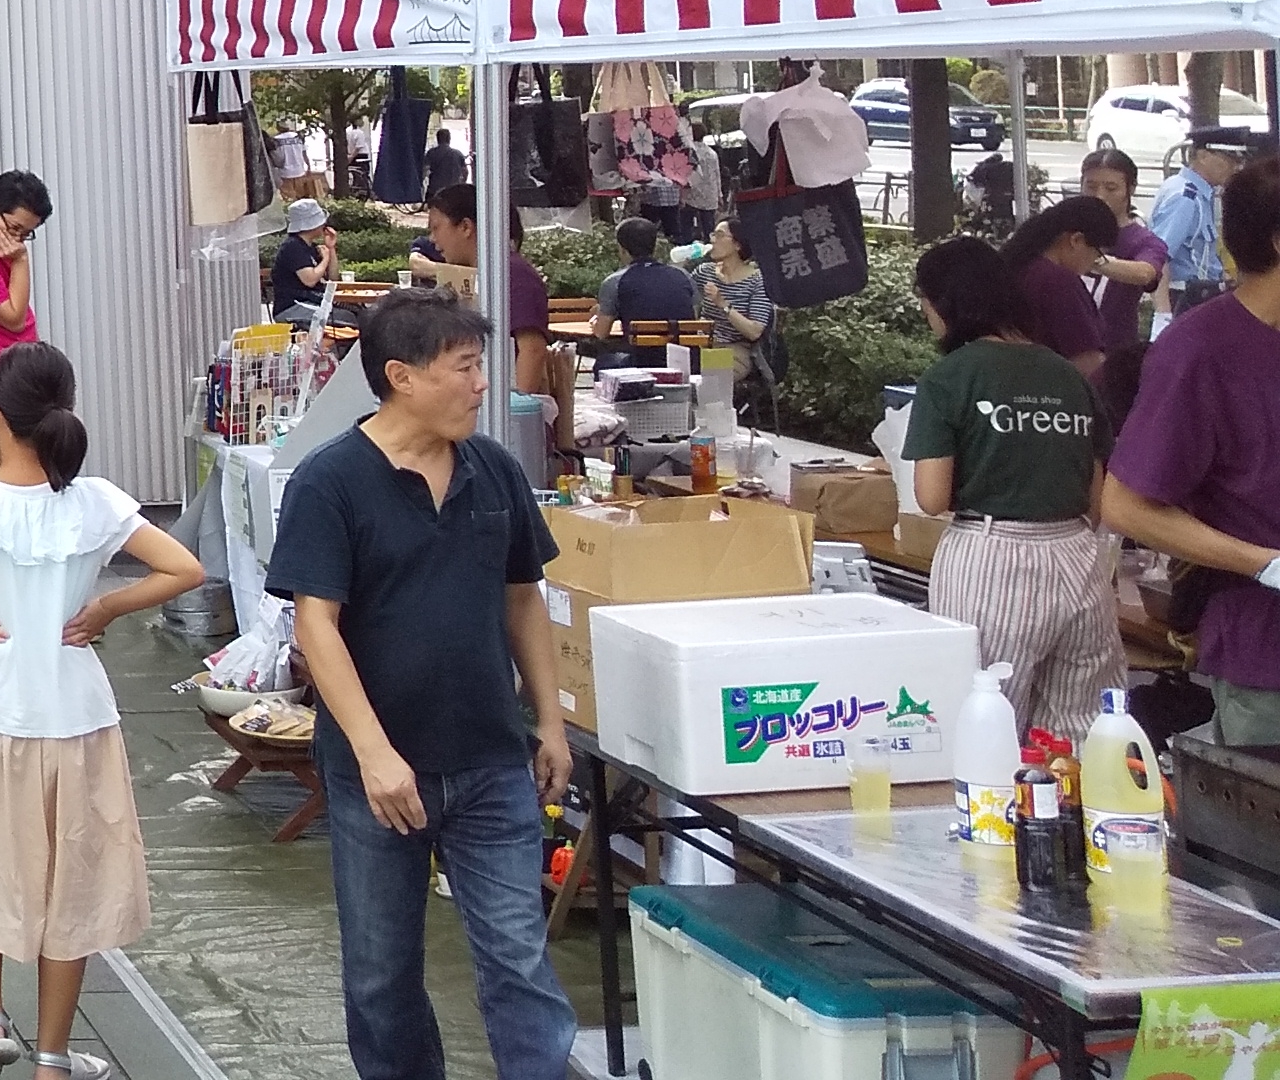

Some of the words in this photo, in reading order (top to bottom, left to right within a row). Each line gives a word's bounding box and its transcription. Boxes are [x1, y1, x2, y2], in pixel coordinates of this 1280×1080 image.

[1040, 395, 1062, 405] shop
[990, 404, 1092, 436] Green
[752, 689, 802, 705] 北海道産
[734, 696, 888, 751] ブロッコリー
[785, 744, 811, 758] 共選
